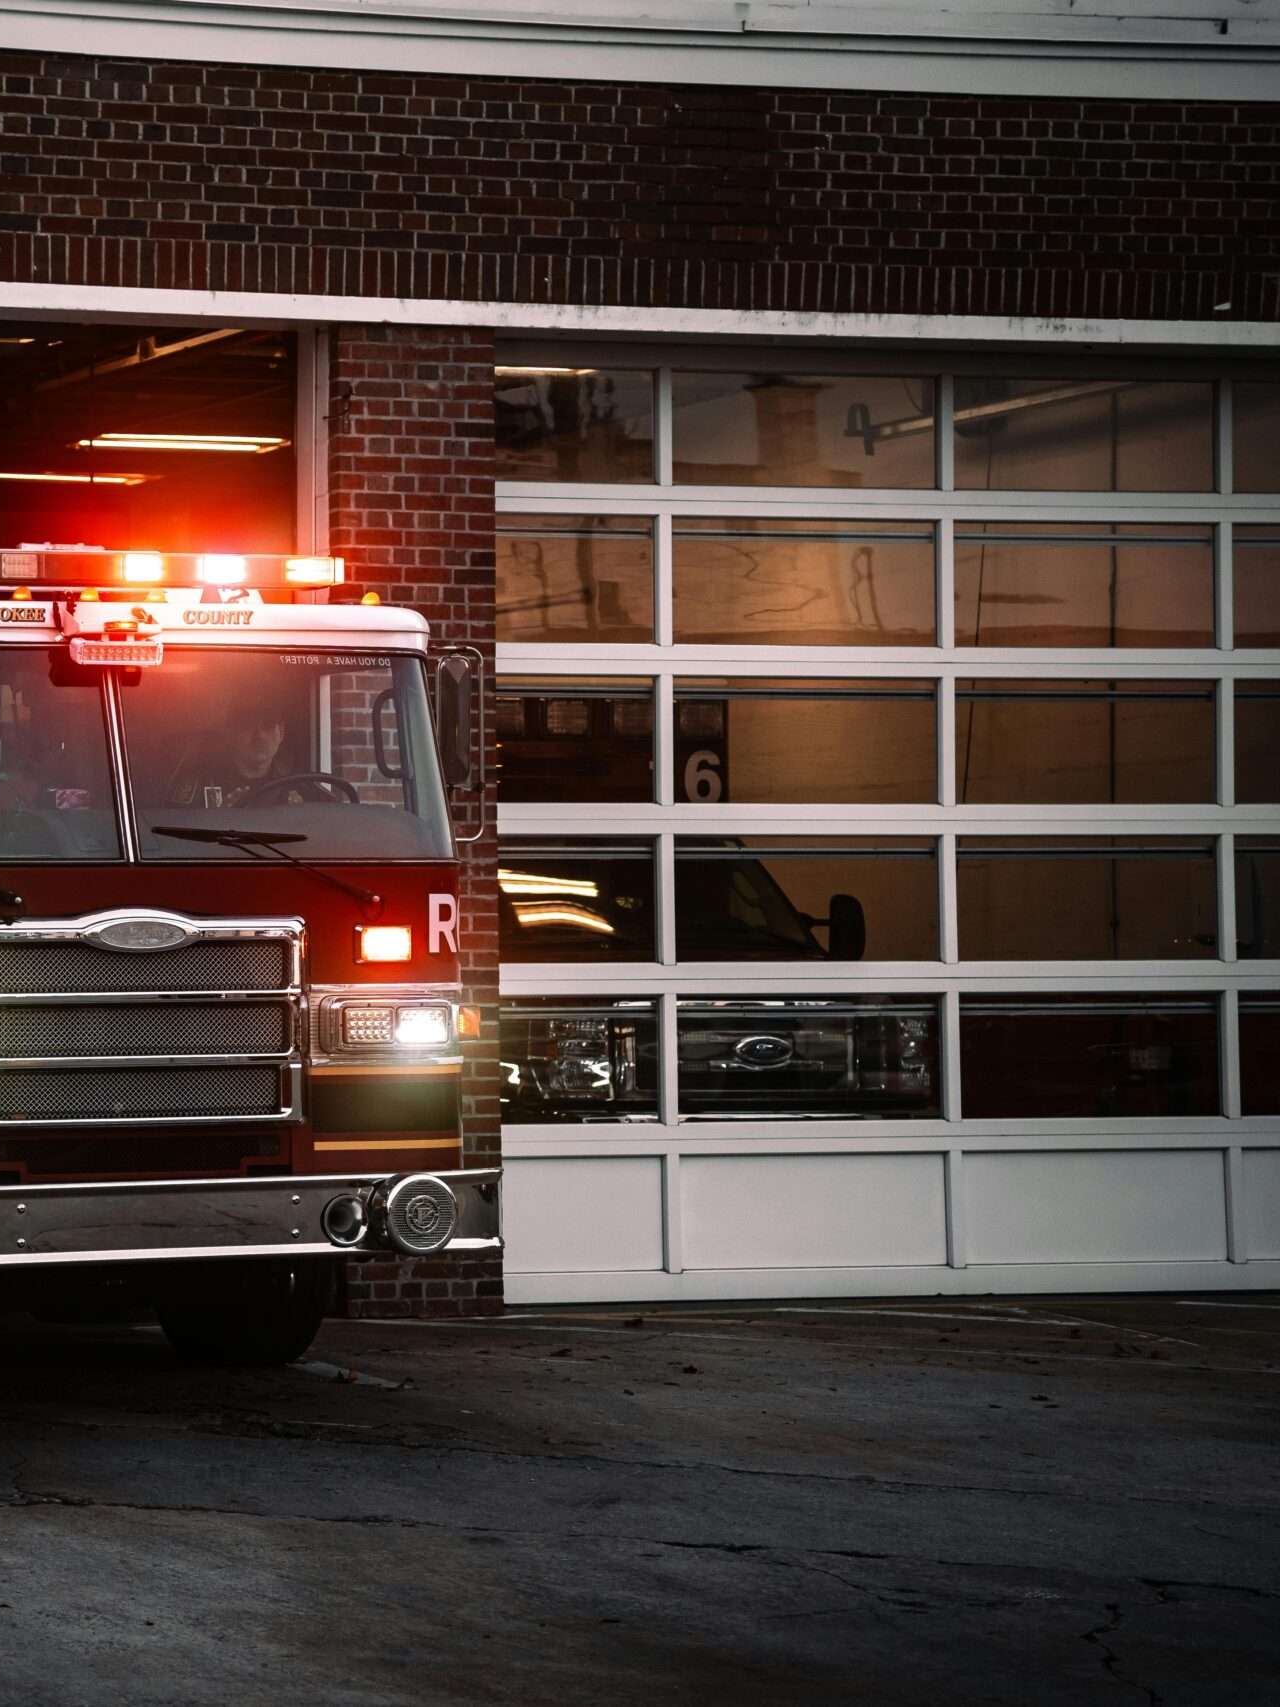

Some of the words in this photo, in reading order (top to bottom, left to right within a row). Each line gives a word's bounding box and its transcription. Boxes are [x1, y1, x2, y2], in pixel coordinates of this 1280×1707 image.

[183, 610, 254, 625] COUNTY
[684, 750, 723, 803] 6
[428, 893, 460, 953] R
